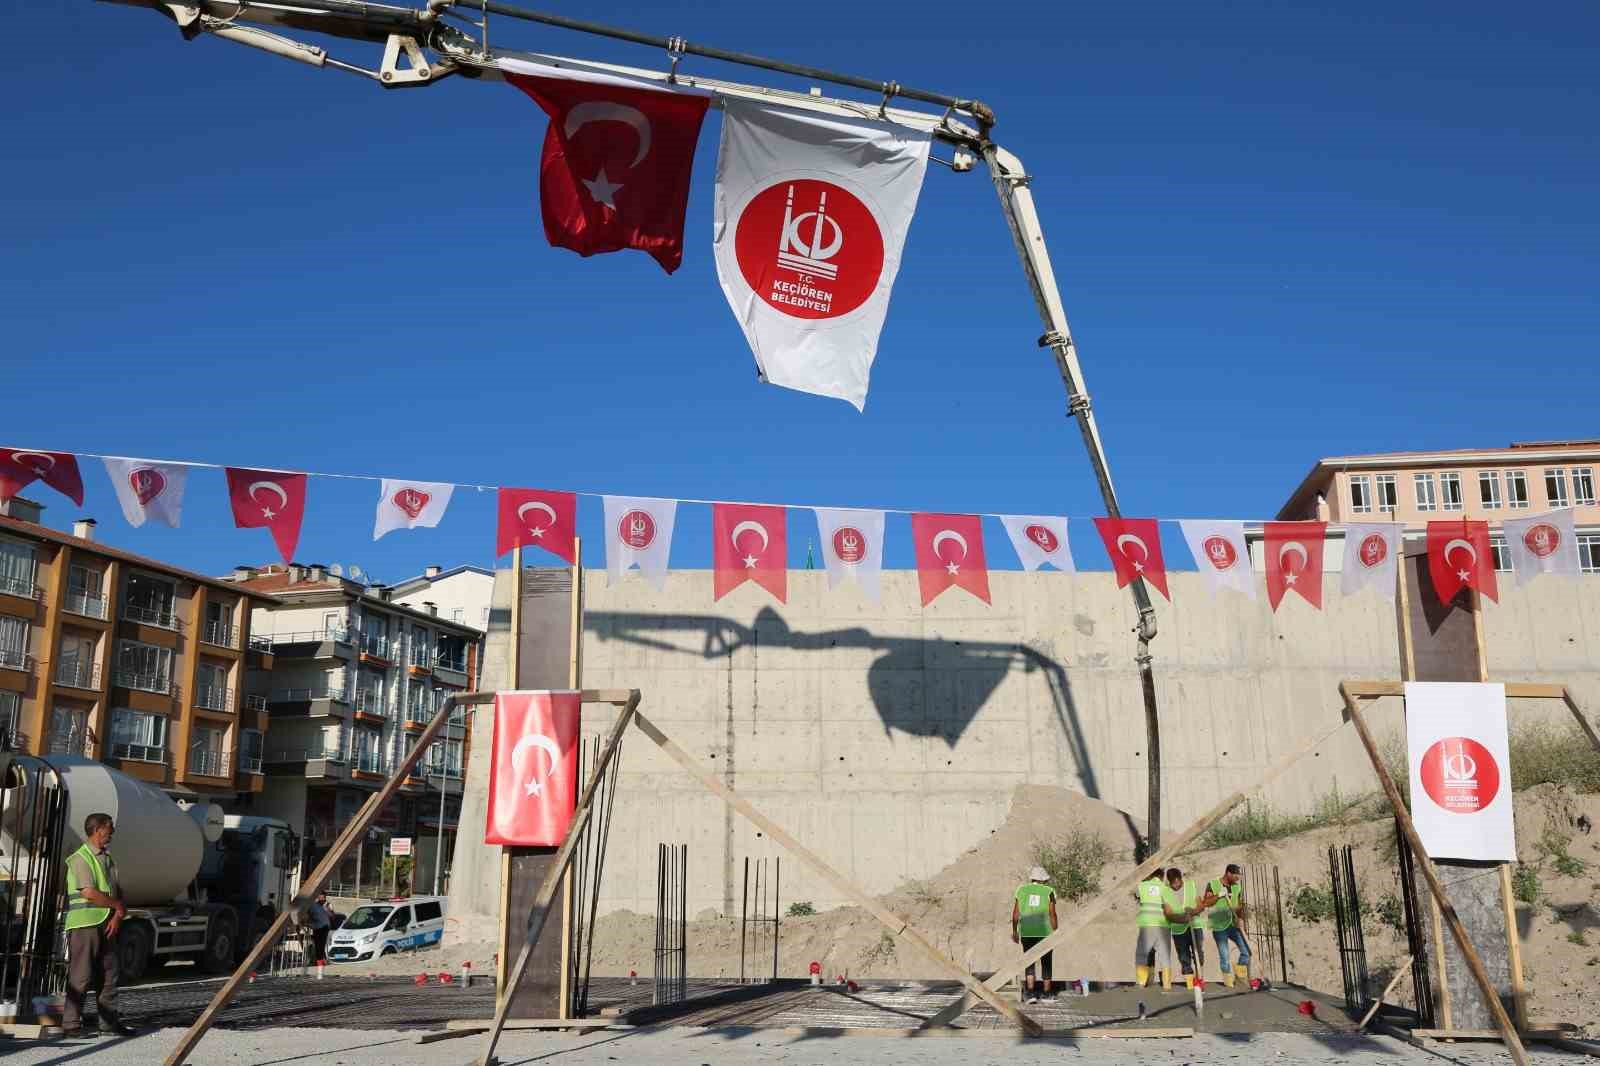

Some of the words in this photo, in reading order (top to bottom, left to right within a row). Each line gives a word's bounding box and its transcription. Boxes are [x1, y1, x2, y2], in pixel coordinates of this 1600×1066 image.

[798, 273, 815, 284] T.C.
[773, 280, 832, 301] KEÇİÖREN
[771, 292, 830, 312] BELEDİYESİ
